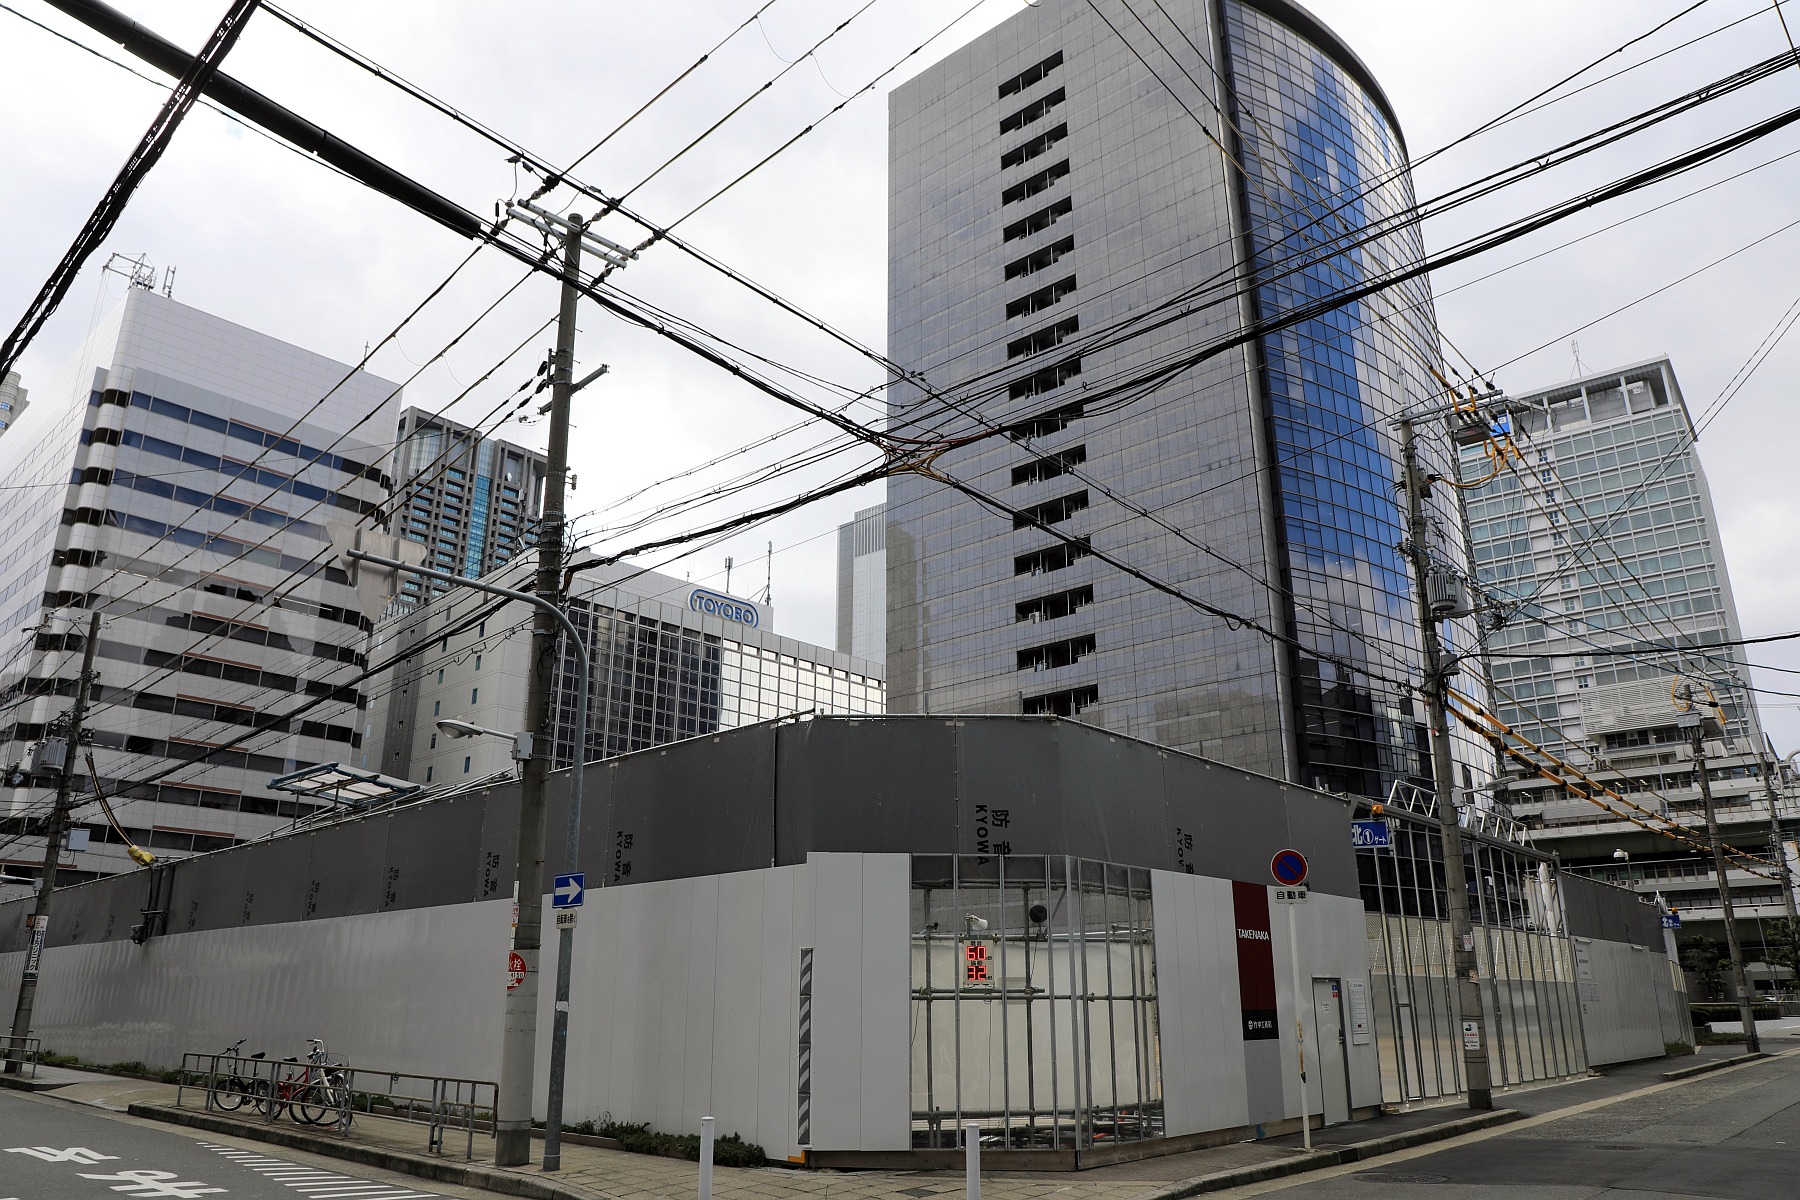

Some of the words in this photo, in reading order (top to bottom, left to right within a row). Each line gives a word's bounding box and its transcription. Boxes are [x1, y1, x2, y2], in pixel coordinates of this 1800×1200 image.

[696, 595, 753, 625] TOYOBO
[976, 804, 989, 866] KYOWA
[483, 851, 492, 897] KYOWA
[490, 854, 500, 893] 防音
[614, 831, 623, 882] KYOWA
[622, 833, 633, 877] 防音
[385, 866, 394, 907] KYOWA
[1276, 890, 1306, 900] 自動車
[966, 946, 986, 960] 60
[1237, 928, 1269, 940] TAKENAKA
[968, 966, 986, 980] 32
